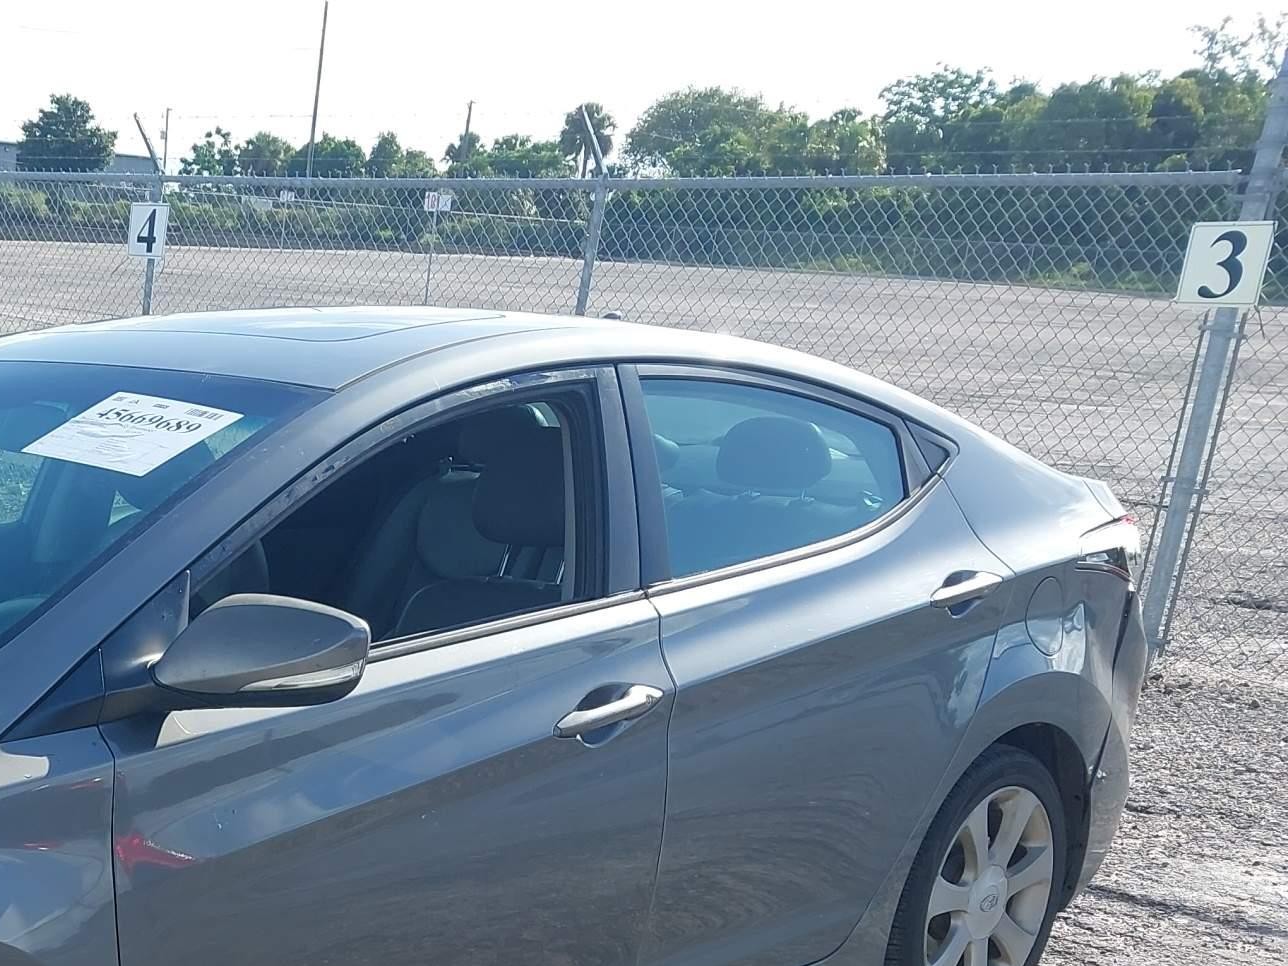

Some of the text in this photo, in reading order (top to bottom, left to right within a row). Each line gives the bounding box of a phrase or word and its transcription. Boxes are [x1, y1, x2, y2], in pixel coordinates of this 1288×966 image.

[137, 208, 157, 253] 4
[1197, 230, 1248, 299] 3
[96, 407, 202, 434] 45669689
